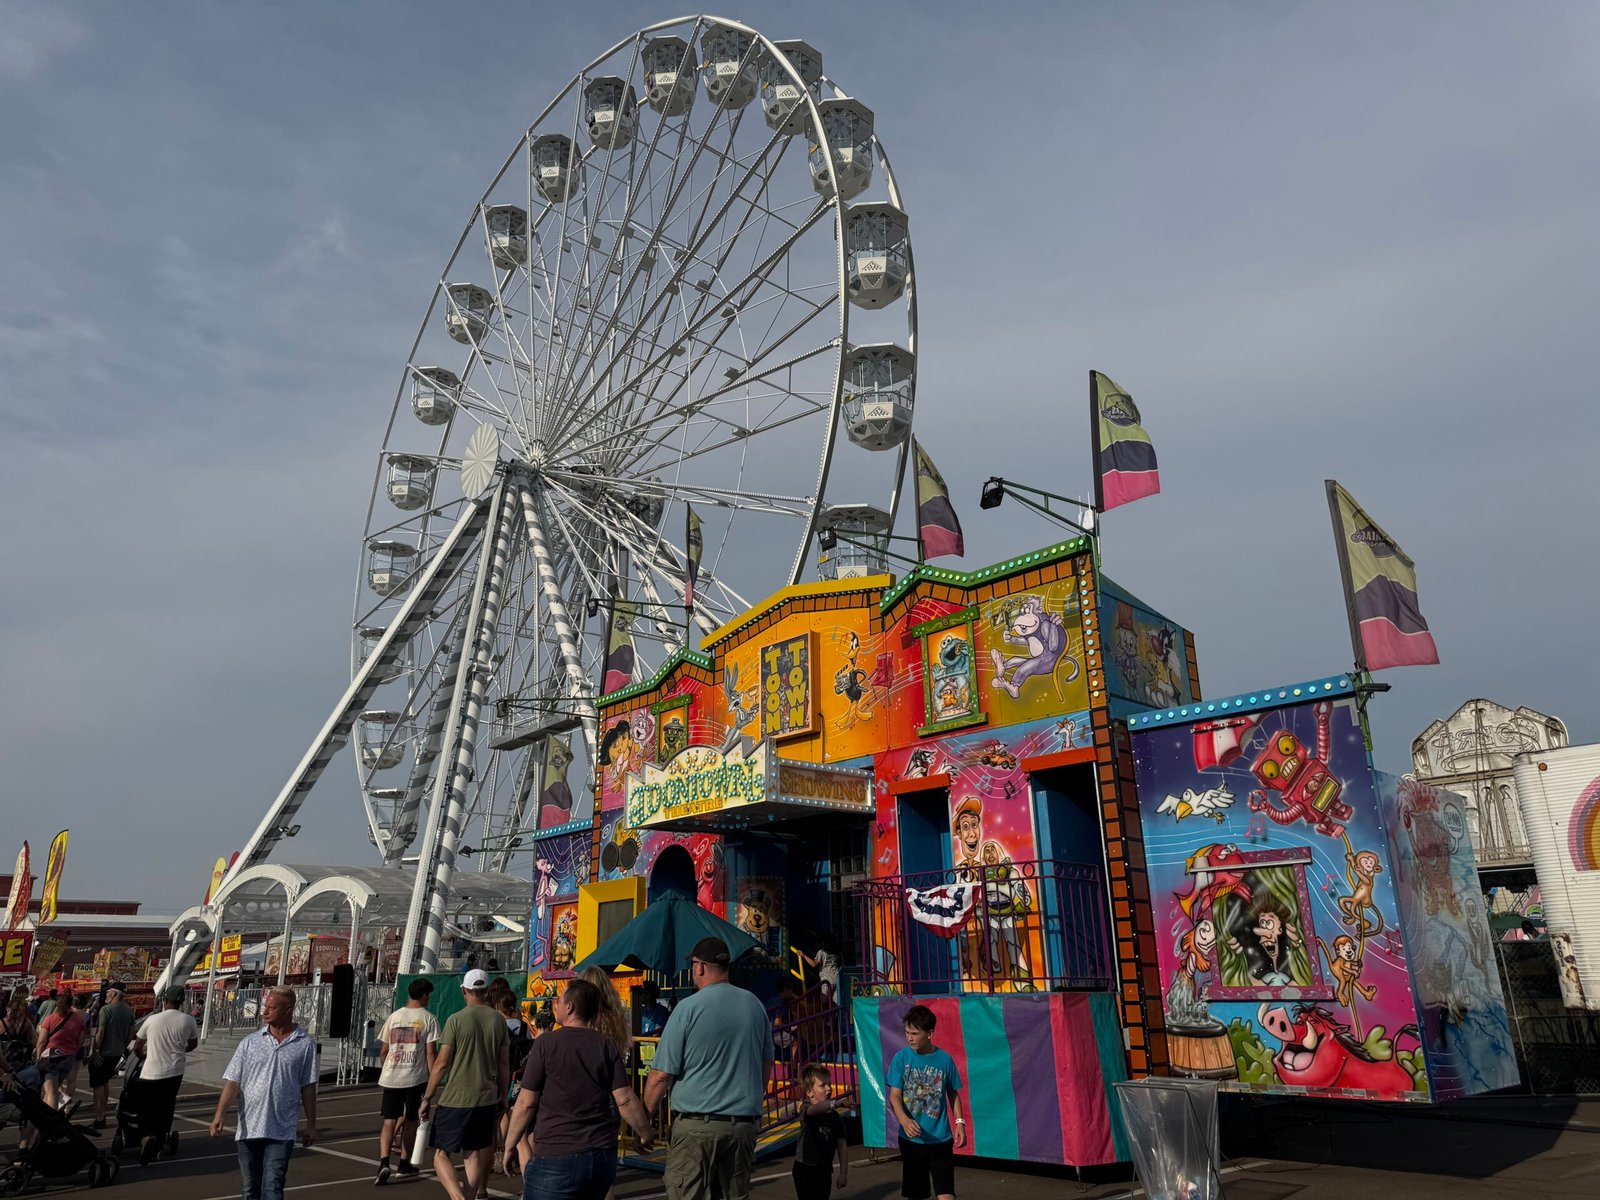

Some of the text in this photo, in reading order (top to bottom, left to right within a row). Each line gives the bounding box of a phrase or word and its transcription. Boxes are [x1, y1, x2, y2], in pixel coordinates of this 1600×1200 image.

[765, 647, 781, 734] TOON
[786, 640, 806, 728] TOWN
[780, 767, 867, 803] SHOWING
[663, 797, 724, 820] THEATRE
[0, 937, 25, 966] E
